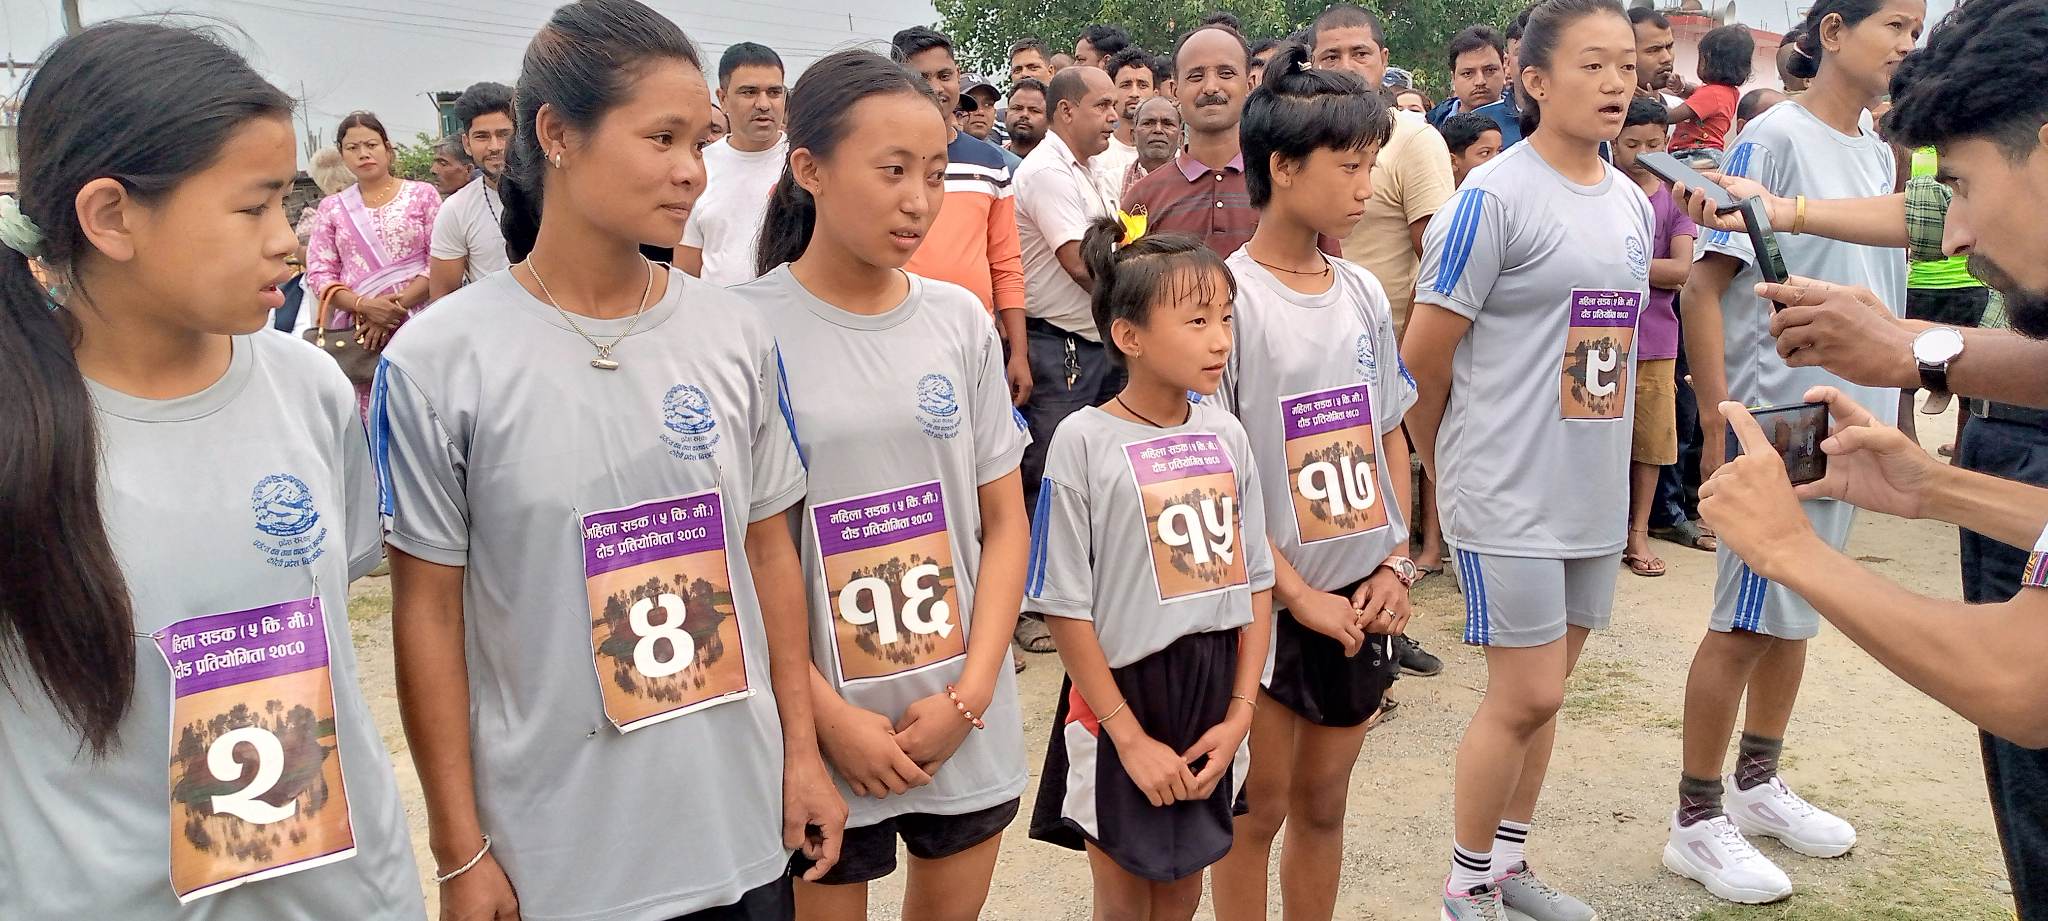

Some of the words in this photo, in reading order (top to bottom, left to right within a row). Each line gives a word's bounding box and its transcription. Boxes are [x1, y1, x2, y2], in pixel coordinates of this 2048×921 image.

[1298, 455, 1376, 517] १७
[620, 516, 650, 532] सडक
[671, 508, 690, 522] कि.
[830, 509, 862, 524] महिला
[864, 503, 890, 518] सडक
[906, 495, 921, 508] कि.
[841, 526, 860, 541] दौड
[862, 517, 910, 538] प्रतियोगिता
[911, 512, 933, 526] २०८०
[595, 543, 615, 559] दौड
[617, 532, 674, 555] प्रतियोगिता
[677, 527, 706, 541] २०८०
[1157, 496, 1234, 566] १५
[838, 564, 956, 645] १६
[172, 633, 195, 653] हिला
[198, 626, 237, 646] सडक
[261, 616, 284, 635] कि.
[629, 593, 695, 677] ४
[174, 660, 193, 680] दौड
[195, 647, 266, 676] प्रतियोगिता
[268, 641, 305, 659] २०८०
[207, 727, 296, 825] २
